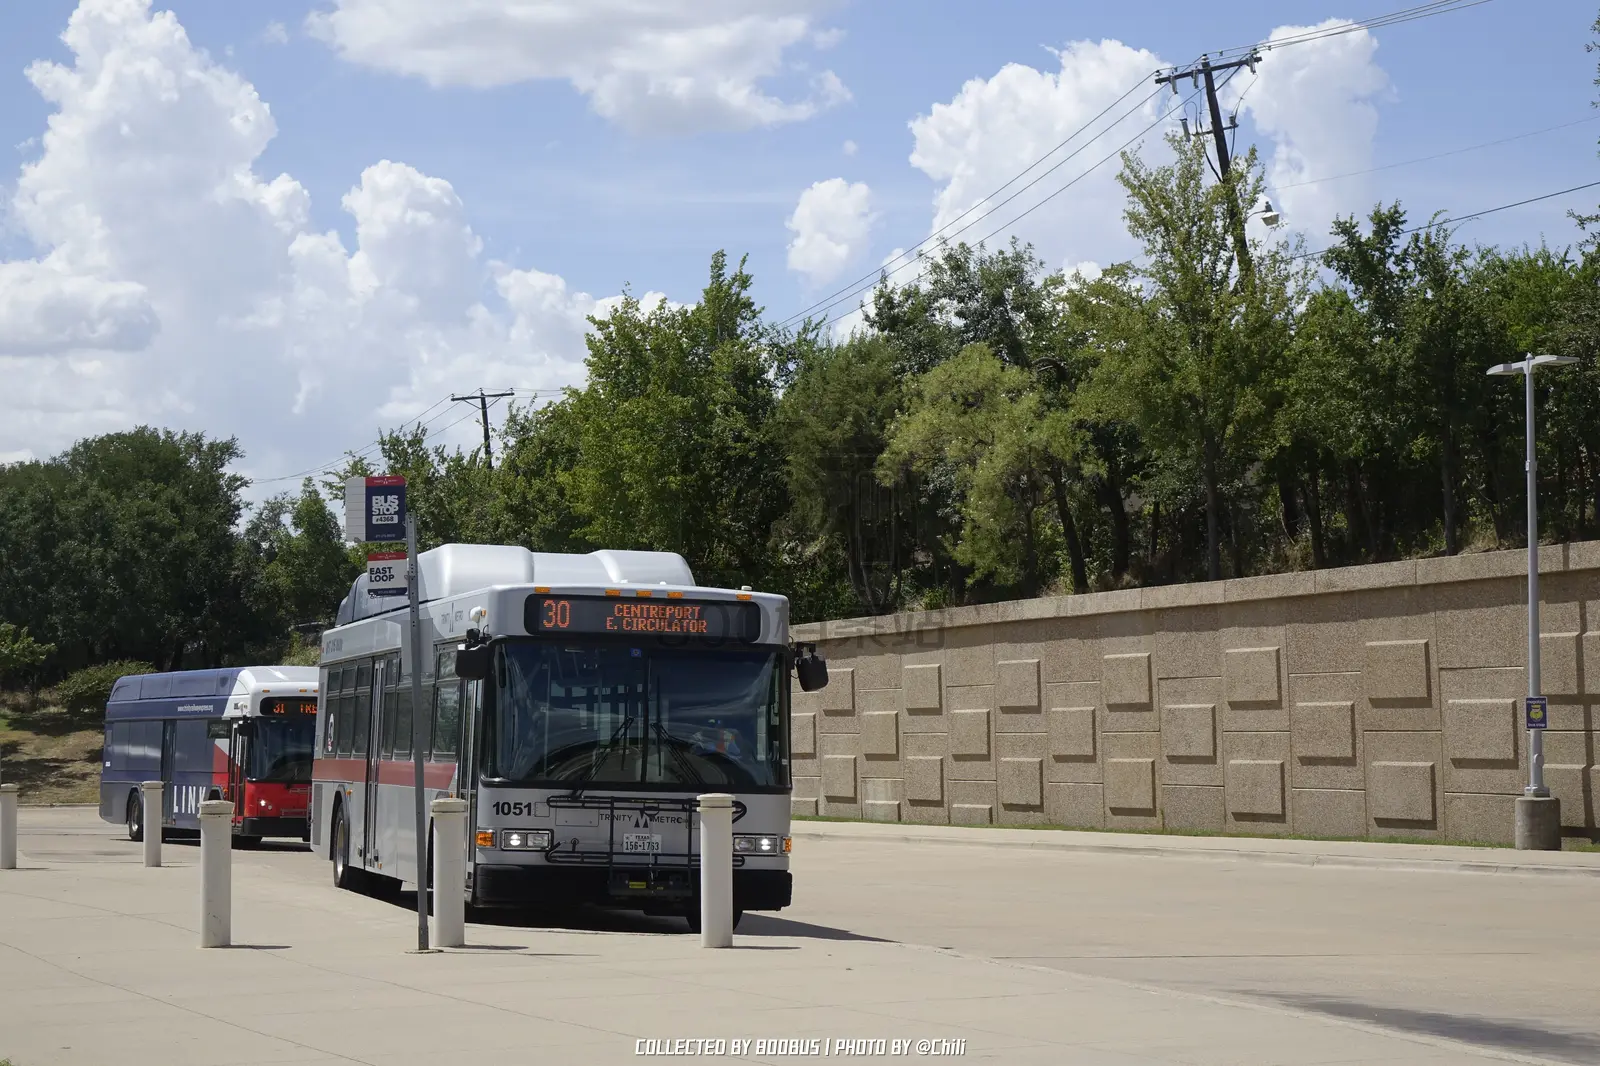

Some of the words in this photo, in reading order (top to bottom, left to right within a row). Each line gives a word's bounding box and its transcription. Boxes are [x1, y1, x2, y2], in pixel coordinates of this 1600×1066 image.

[372, 495, 399, 507] BUS
[372, 506, 398, 515] STOP
[375, 515, 395, 523] #4368
[369, 566, 393, 575] EAST
[369, 574, 395, 583] LOOP
[542, 599, 571, 628] 30
[614, 604, 701, 619] CENTREPORT
[606, 616, 618, 630] E.
[622, 617, 708, 633] CIRCULATOR
[492, 801, 533, 817] 1051
[599, 813, 632, 822] TRNITY
